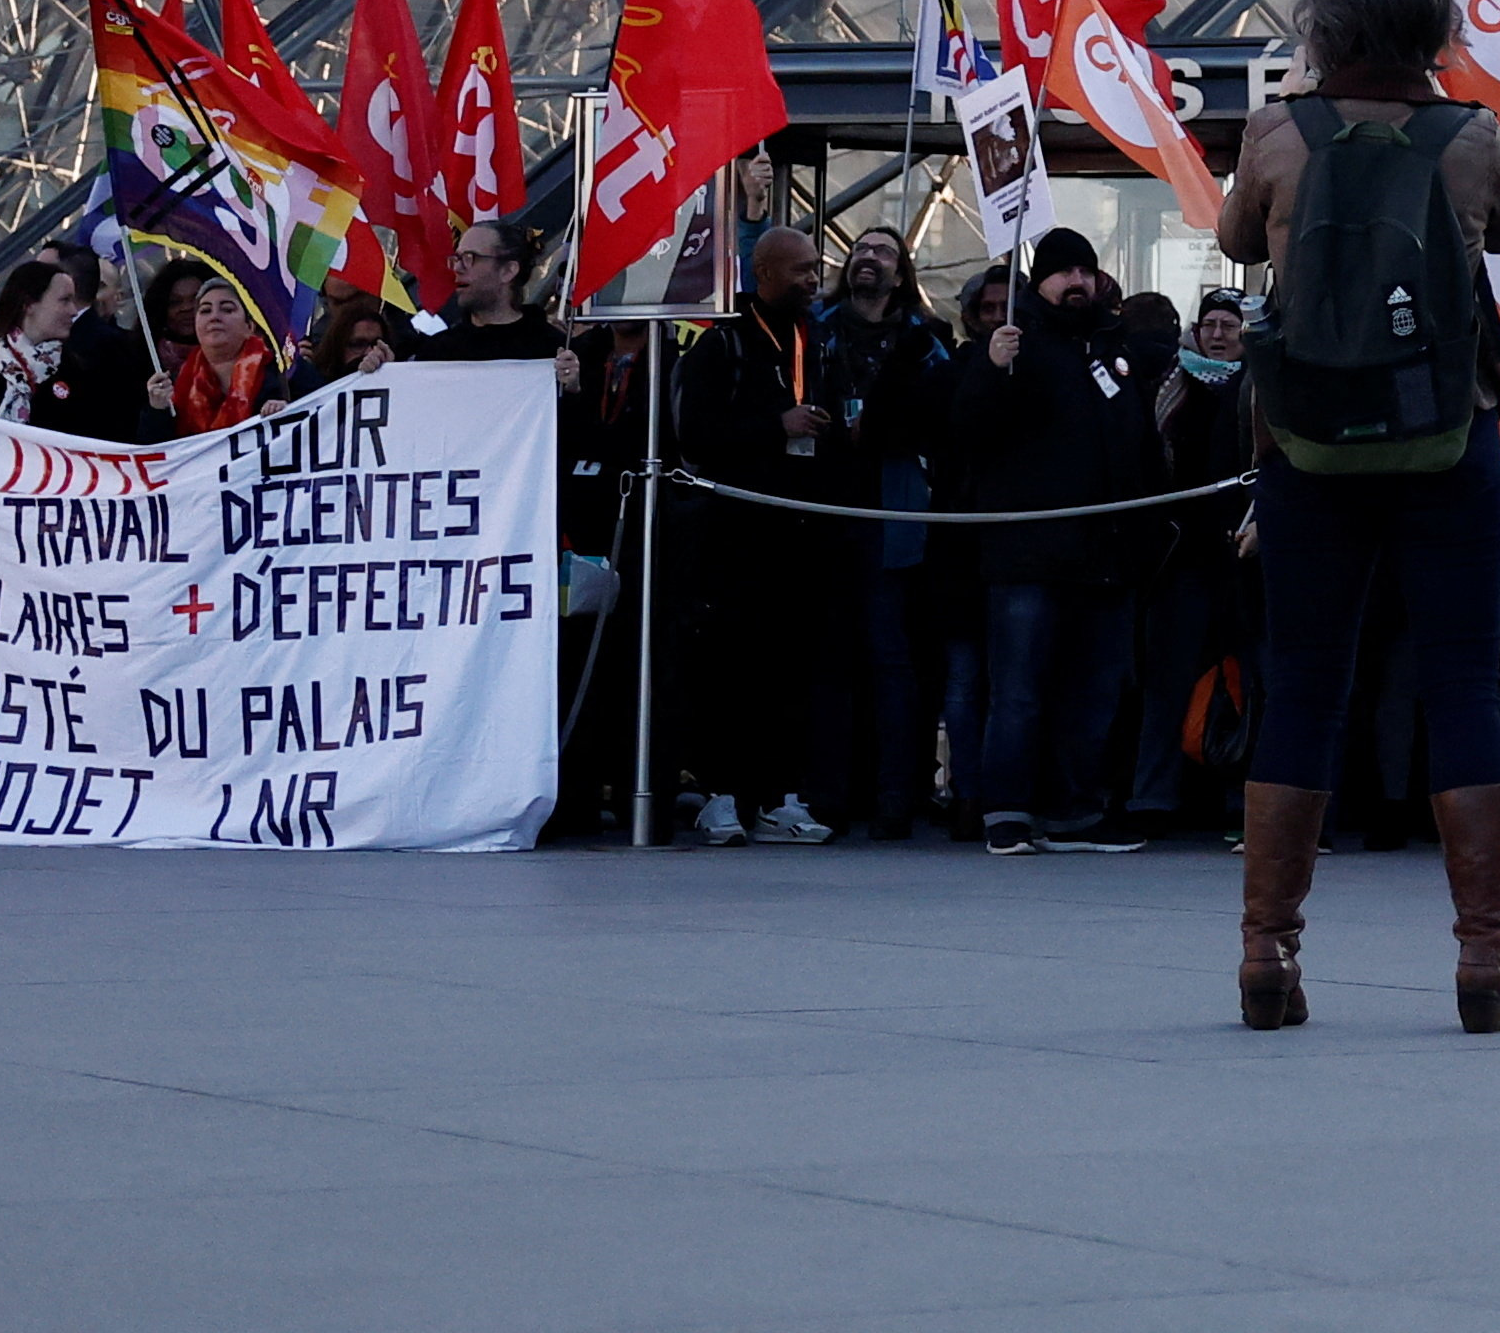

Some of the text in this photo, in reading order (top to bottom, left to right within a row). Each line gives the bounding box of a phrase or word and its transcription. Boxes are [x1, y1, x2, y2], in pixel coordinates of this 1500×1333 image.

[219, 388, 390, 482] POUR
[4, 495, 189, 567] TRAVAIL
[220, 469, 481, 554] DÉCENTES
[233, 553, 533, 642] D'EFFECTIFS
[140, 687, 208, 759] DU
[241, 673, 428, 756] PALAIS
